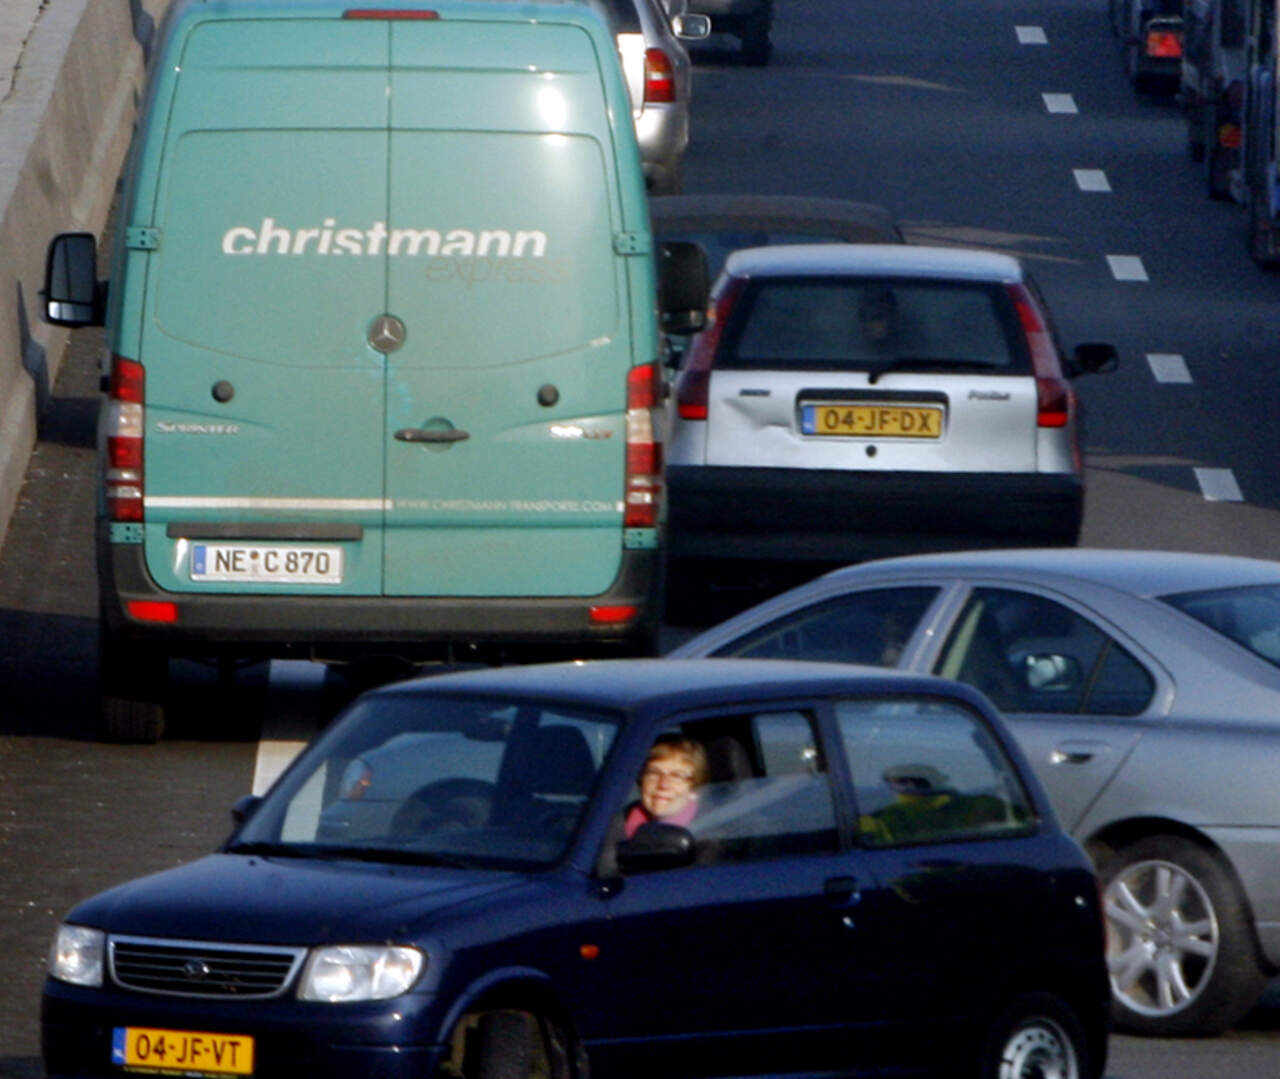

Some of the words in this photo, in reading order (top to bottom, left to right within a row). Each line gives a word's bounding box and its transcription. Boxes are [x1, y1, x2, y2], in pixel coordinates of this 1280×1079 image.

[221, 217, 548, 257] christmann
[824, 408, 932, 433] 04-JF-DX
[215, 549, 246, 572] NE
[264, 550, 279, 573] C
[285, 551, 331, 575] 870
[135, 1033, 242, 1068] 04-JF-VT
